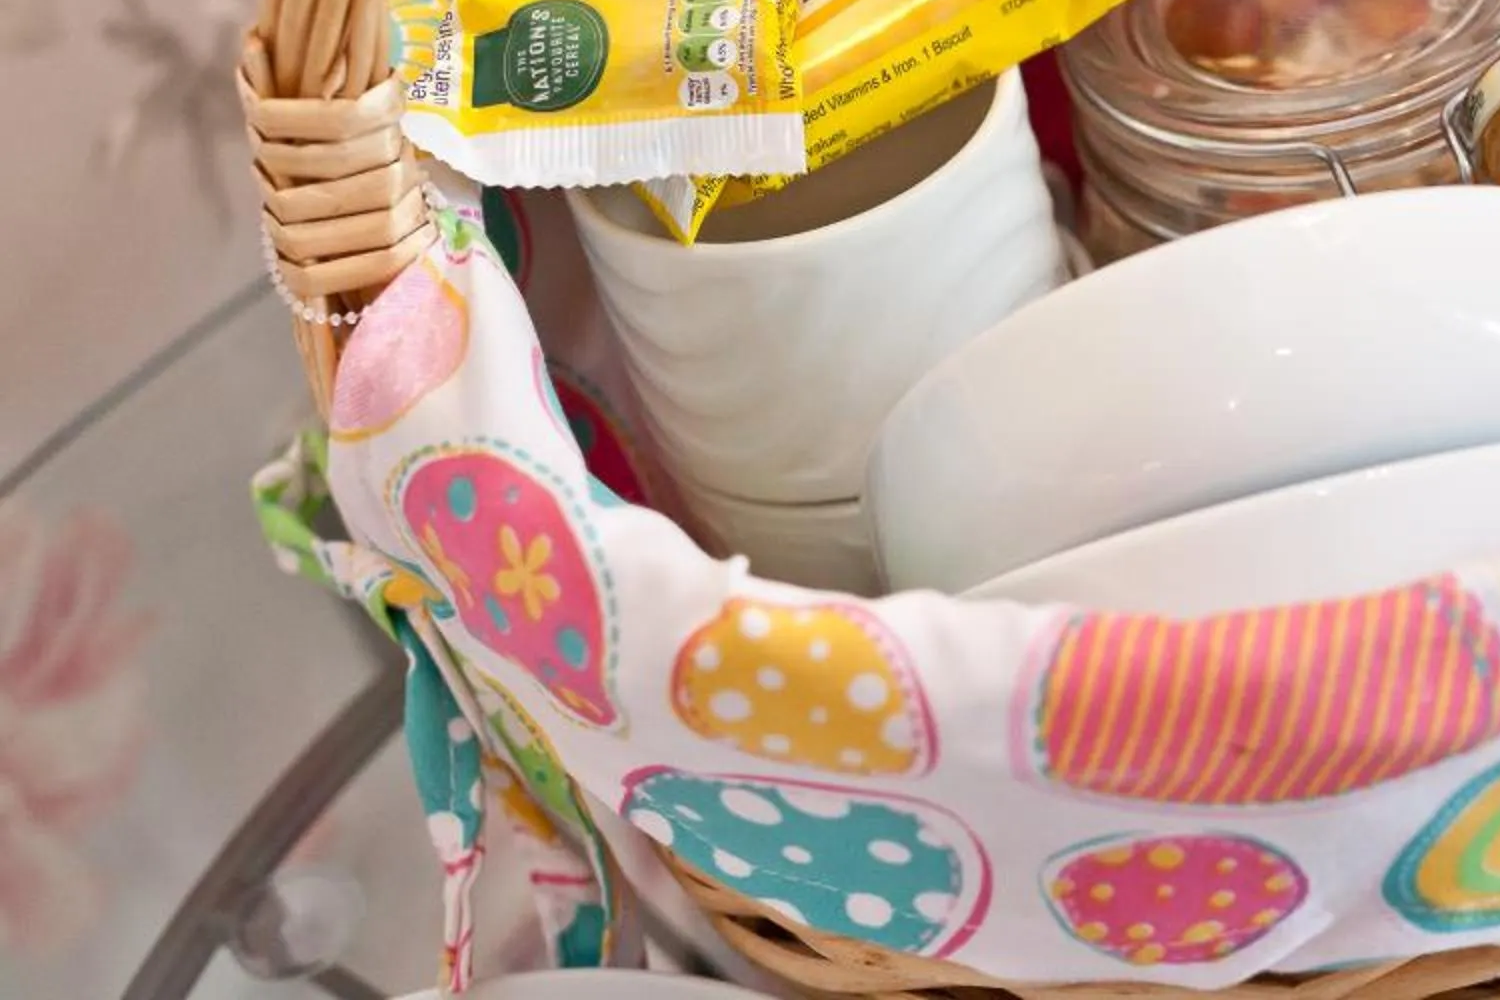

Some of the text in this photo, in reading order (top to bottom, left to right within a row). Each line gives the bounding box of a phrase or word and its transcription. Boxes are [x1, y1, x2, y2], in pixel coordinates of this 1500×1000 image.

[827, 77, 880, 110] Vitamins
[881, 68, 892, 84] &
[932, 25, 974, 57] Biscuit
